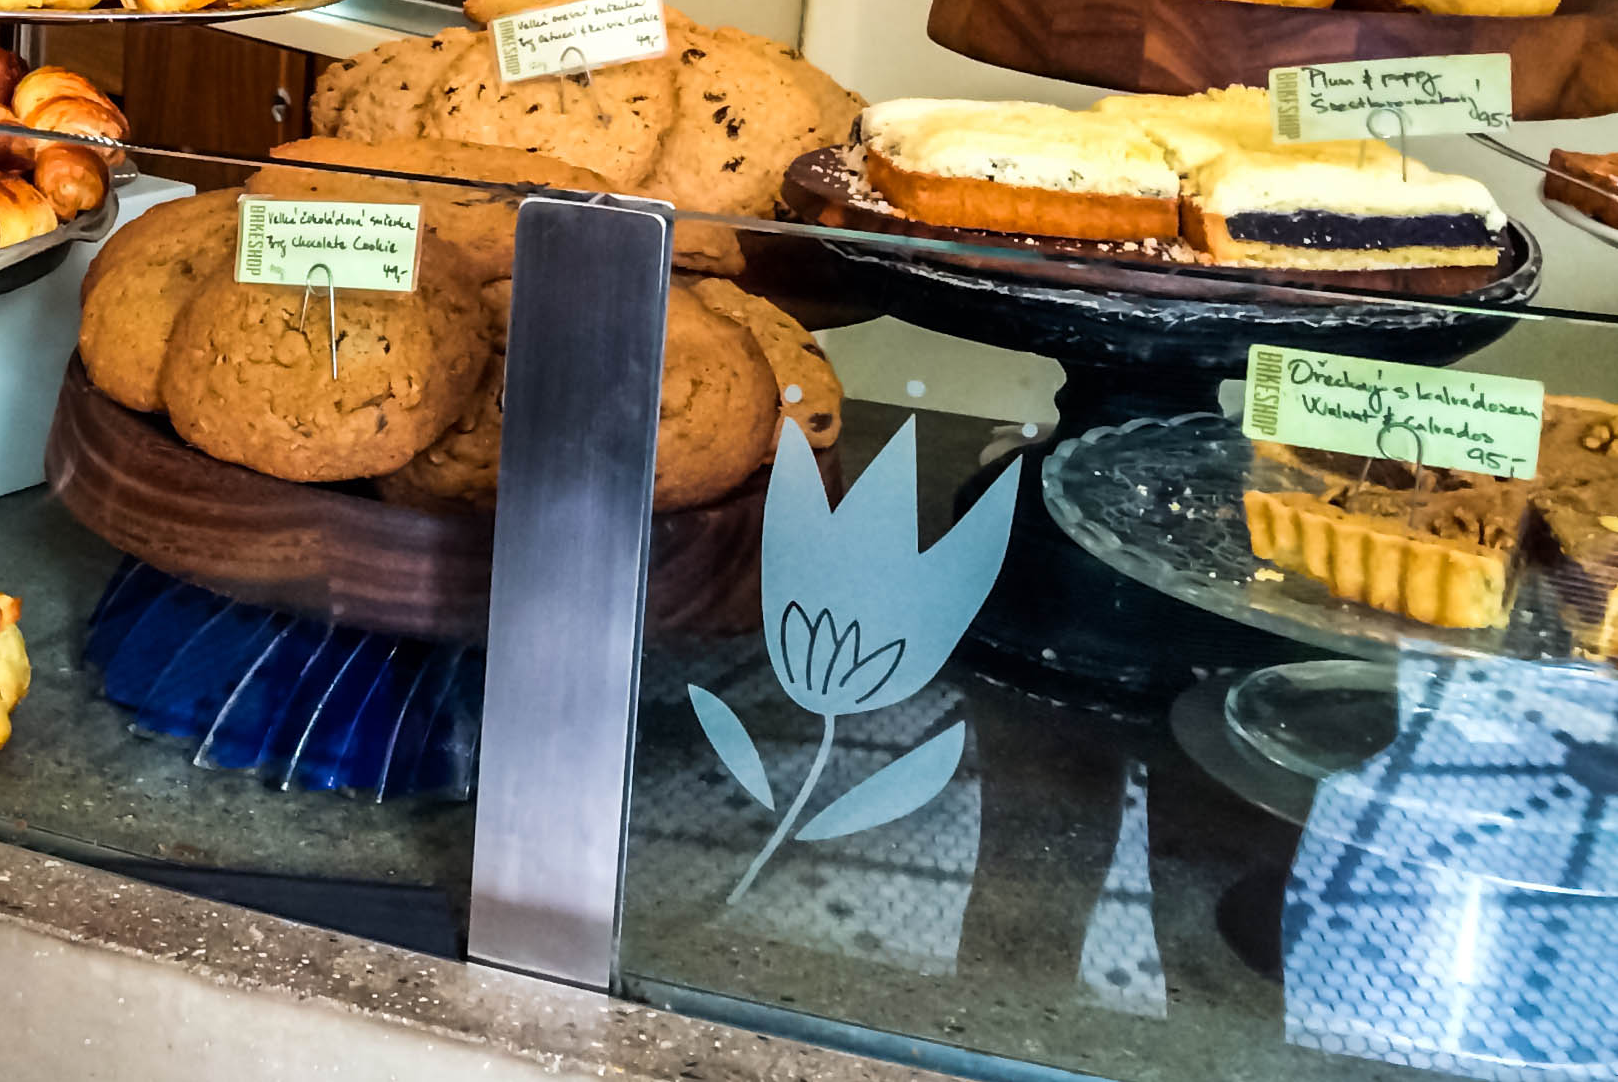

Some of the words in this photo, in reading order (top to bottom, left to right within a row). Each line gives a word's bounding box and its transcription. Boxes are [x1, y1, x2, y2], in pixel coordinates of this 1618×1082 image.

[628, 13, 659, 26] Cookie
[246, 205, 266, 276] BAKESHOP
[353, 236, 399, 254] Cookie
[1251, 351, 1283, 436] BAKESHOP
